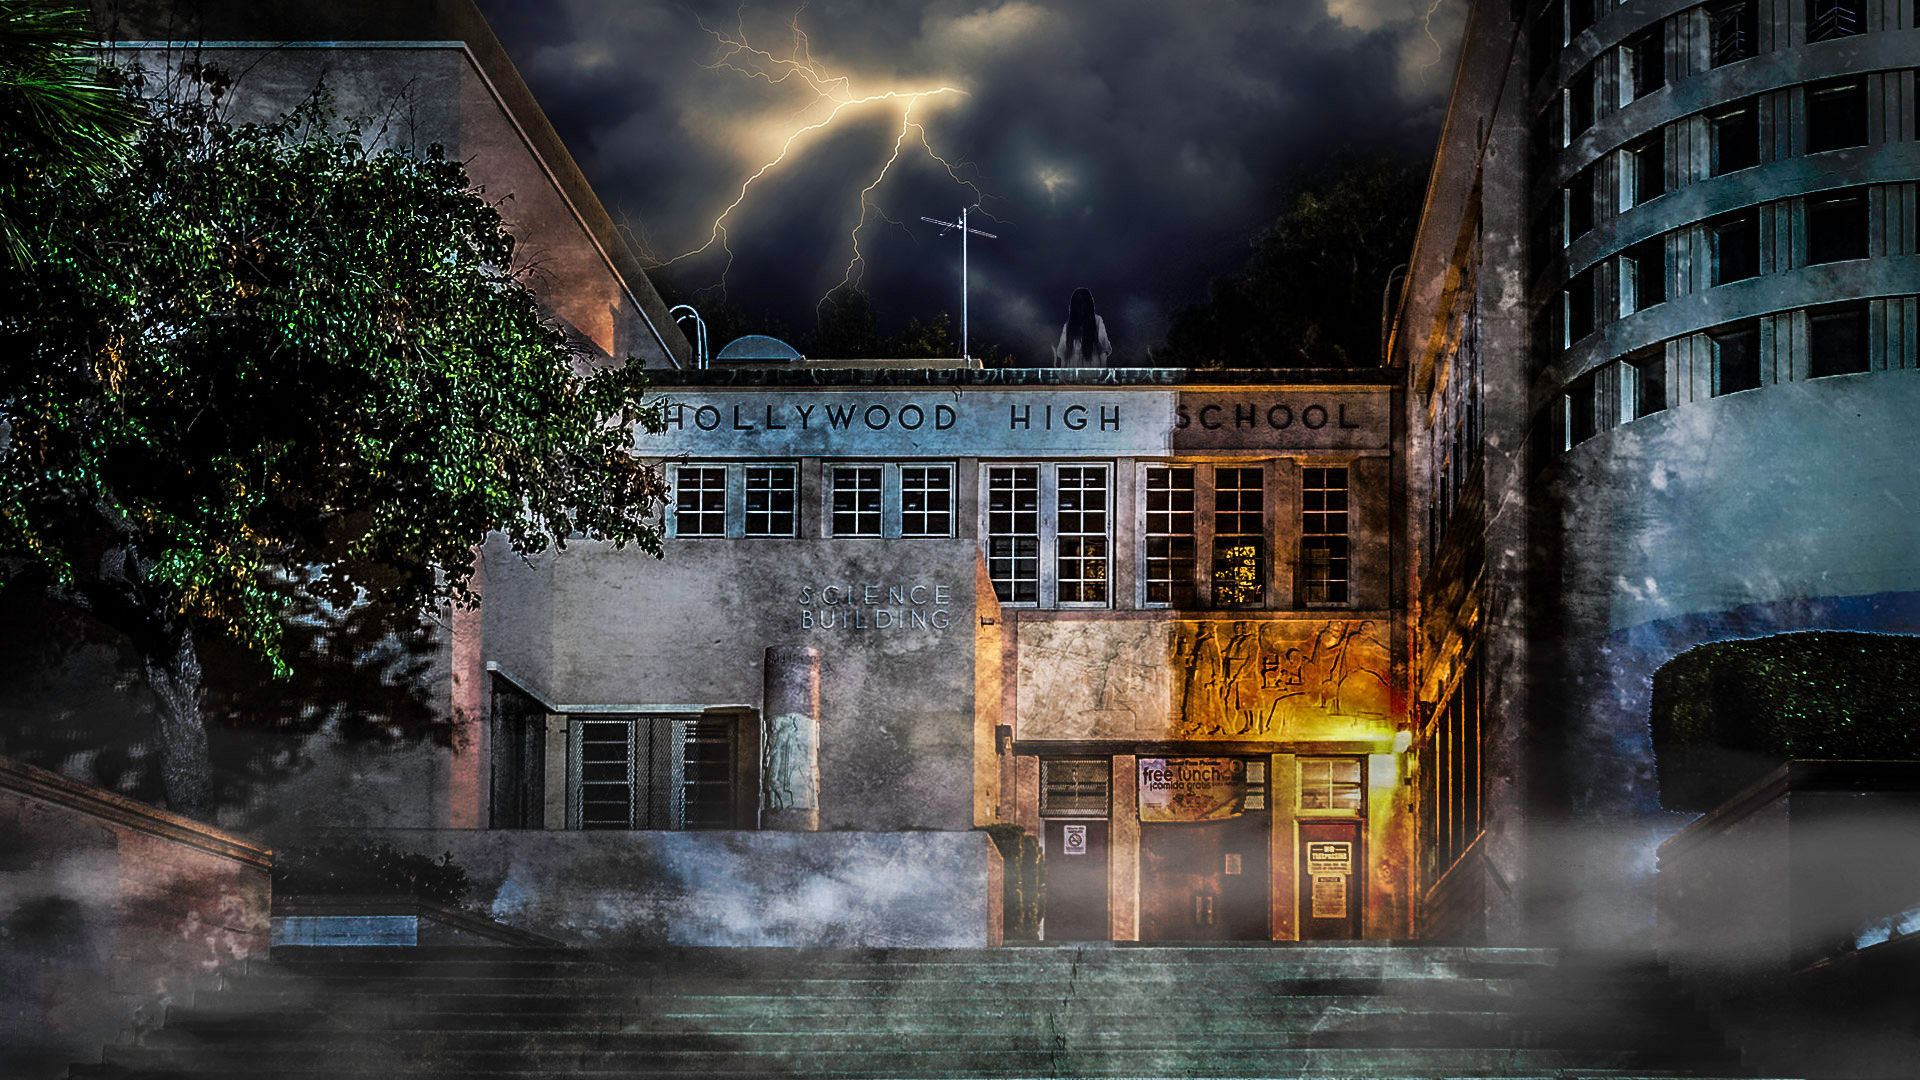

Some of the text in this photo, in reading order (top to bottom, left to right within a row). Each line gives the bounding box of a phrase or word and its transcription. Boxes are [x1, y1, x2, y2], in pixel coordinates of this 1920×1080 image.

[664, 404, 1360, 431] HOLLYWOOD HIGH SCHOOL
[799, 585, 950, 605] SCIENCE
[802, 609, 950, 630] BUILDING
[1143, 767, 1173, 785] free
[1178, 767, 1220, 781] lunch
